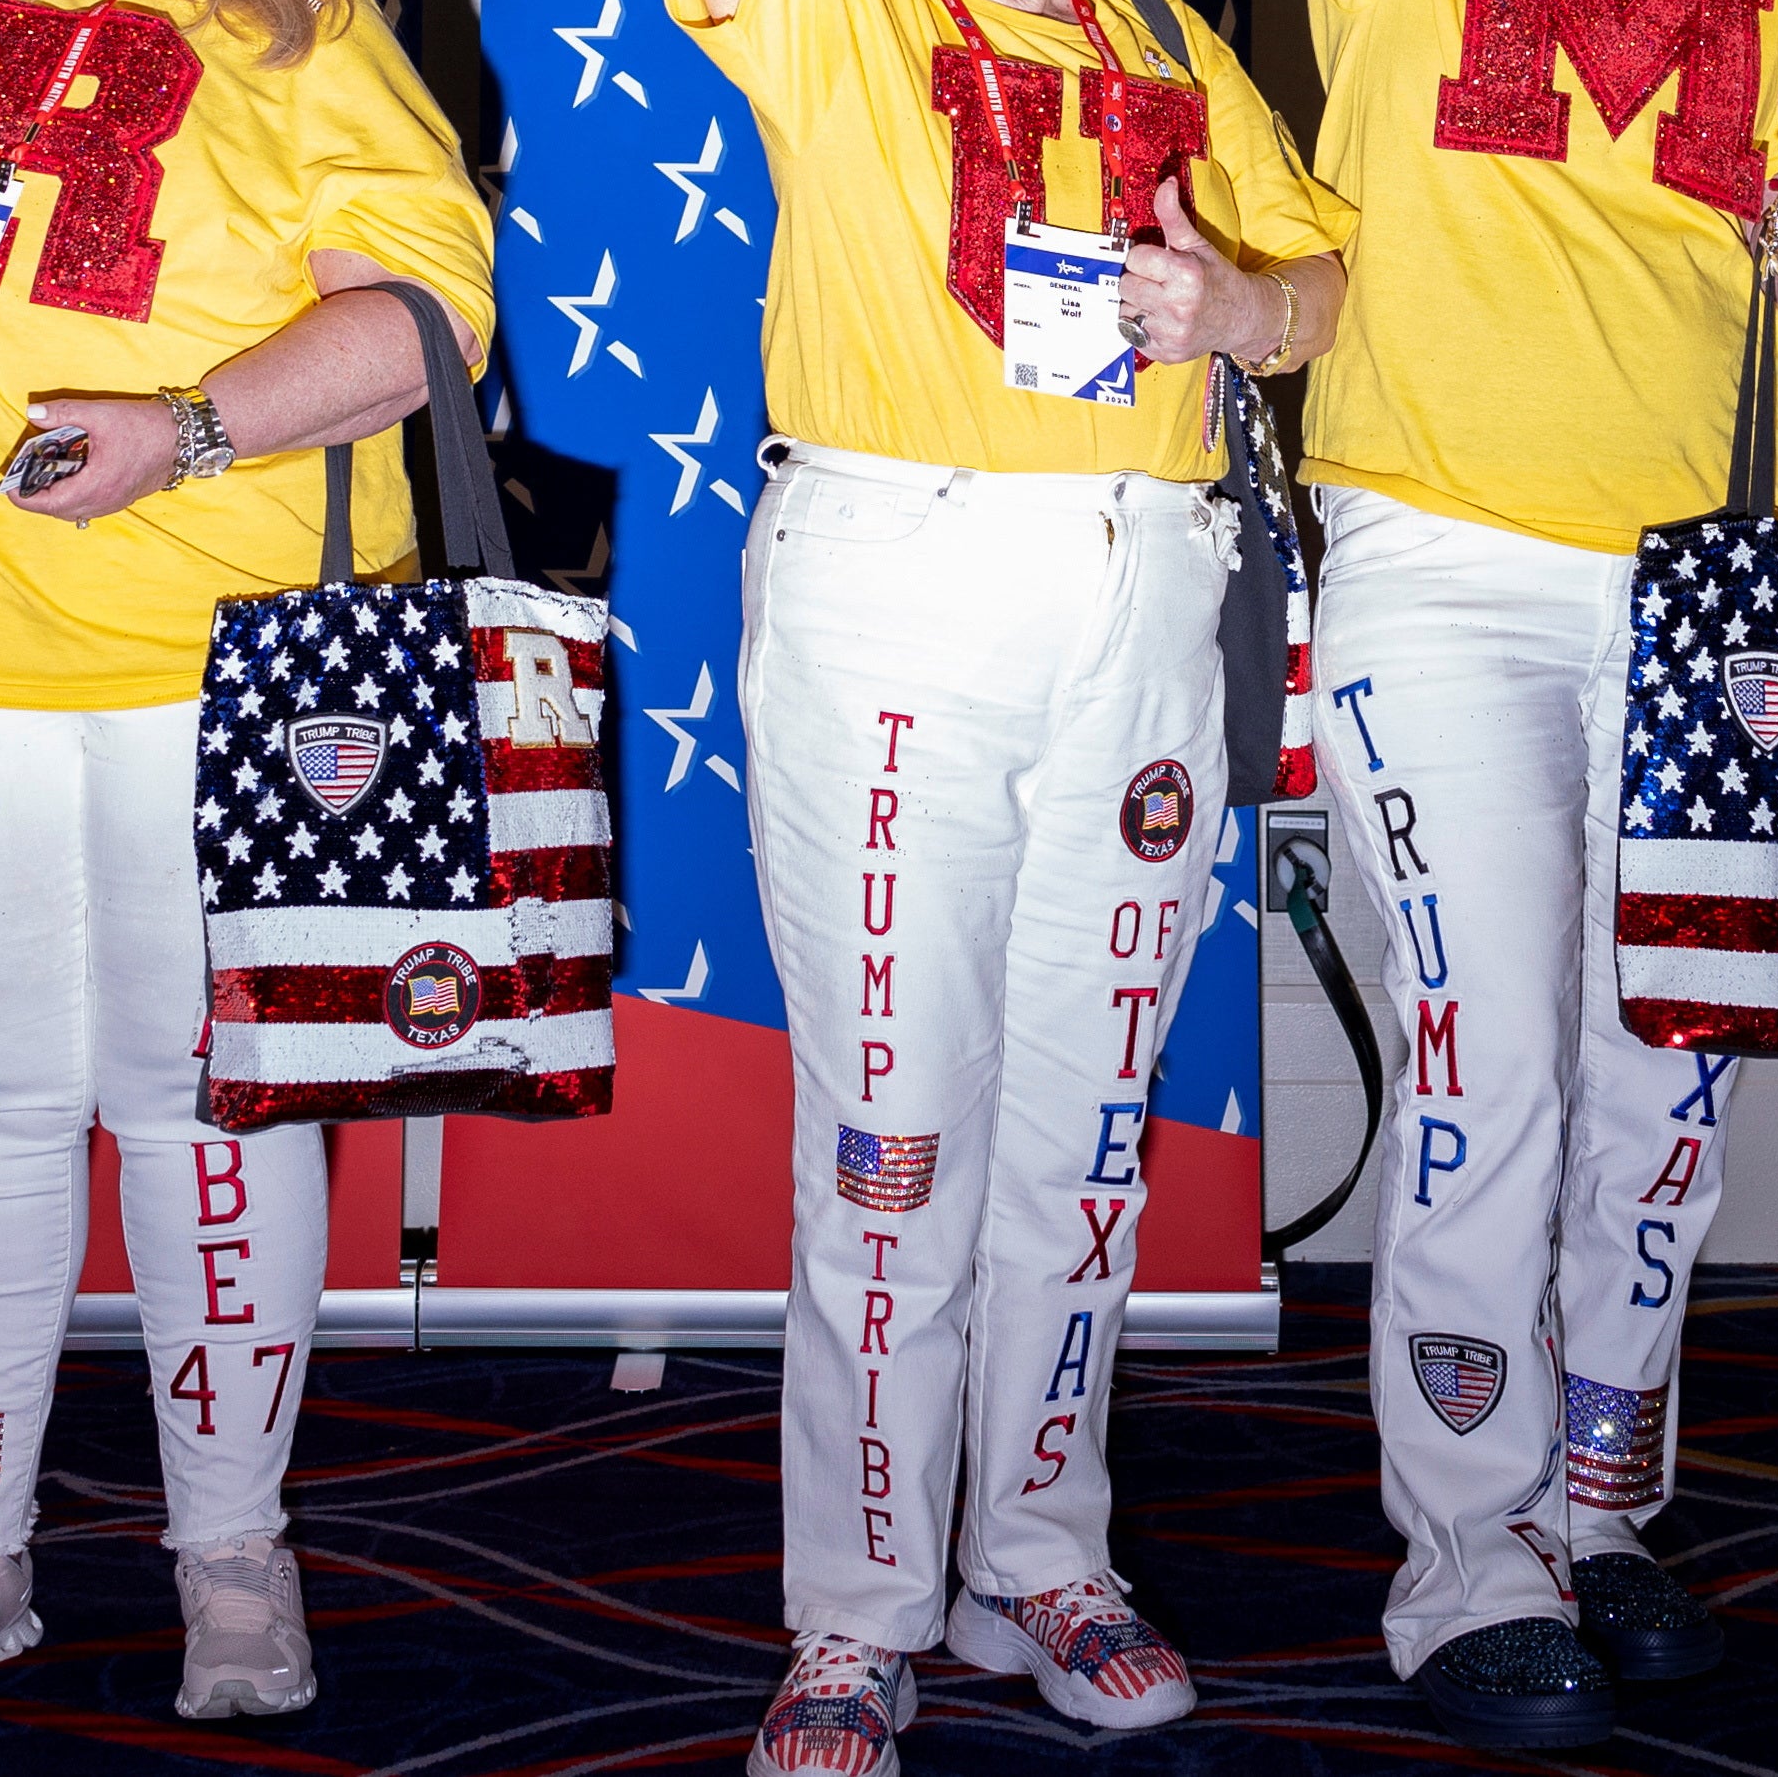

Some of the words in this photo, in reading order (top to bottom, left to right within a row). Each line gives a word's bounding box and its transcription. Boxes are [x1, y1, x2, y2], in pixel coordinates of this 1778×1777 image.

[58, 27, 93, 80] MAMMOTH
[979, 59, 1004, 112] MAMMOTH
[1049, 281, 1083, 293] GENERAL
[1061, 298, 1081, 308] Lisa
[1060, 308, 1082, 318] Wolf
[1105, 395, 1128, 405] 2024
[1733, 661, 1767, 673] TRUMP
[503, 628, 595, 749] R
[299, 726, 340, 743] TRUMP
[345, 727, 377, 743] TRIBE
[1130, 765, 1166, 800] TRUMP
[1171, 767, 1190, 799] TRIBE
[1138, 837, 1175, 857] TEXAS
[860, 710, 914, 1104] TRUMP
[1109, 900, 1179, 961] OF
[1332, 676, 1467, 1208] TRUMP
[390, 948, 435, 987] TRUMP
[446, 949, 477, 986] TRIBE
[406, 1023, 460, 1044] TEXAS
[1629, 1051, 1734, 1308] XAS
[1020, 986, 1159, 1498] TEXAS
[1422, 1345, 1458, 1358] TRUMP
[1463, 1348, 1493, 1365] TRIBE
[168, 1342, 298, 1436] 47
[860, 1230, 898, 1567] TRIBE
